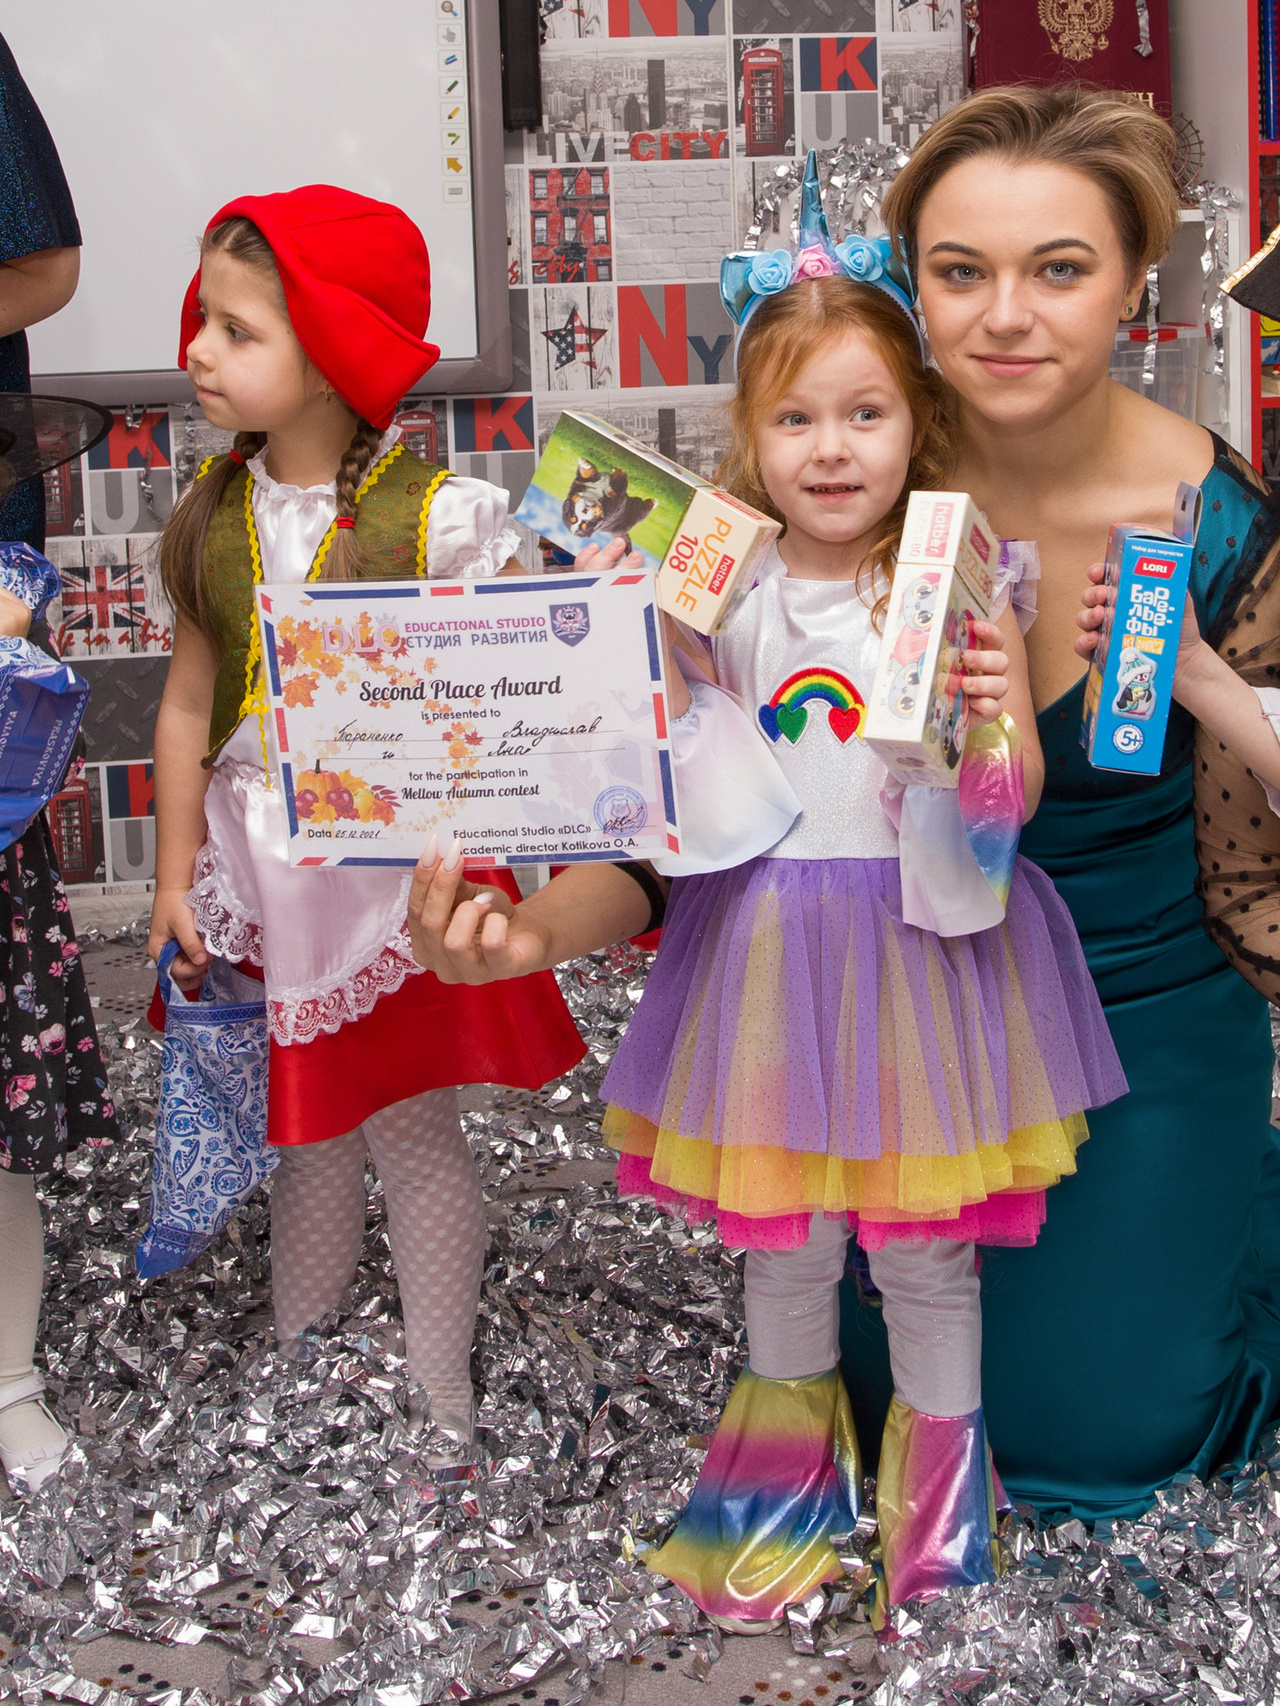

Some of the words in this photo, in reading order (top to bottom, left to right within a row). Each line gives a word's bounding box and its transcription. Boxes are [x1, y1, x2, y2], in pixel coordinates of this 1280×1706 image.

[629, 131, 728, 162] CITY
[474, 396, 534, 452] K
[930, 506, 951, 554] hatber
[668, 534, 698, 573] 108
[675, 516, 732, 612] PUZZLE
[711, 558, 732, 591] hatber
[1142, 562, 1168, 574] LORI
[140, 618, 172, 652] big
[404, 620, 493, 633] EDUCATIONAL
[496, 616, 546, 630] STUDIO
[318, 624, 401, 653] DLC
[406, 634, 462, 650] СТУДИЯ
[471, 630, 548, 646] РАЗВИТИЯ
[359, 680, 427, 702] Second
[430, 679, 486, 700] Place
[490, 675, 564, 700] Award
[421, 711, 429, 720] is
[432, 709, 486, 722] presented
[490, 708, 501, 718] to
[1120, 730, 1142, 746] 5+
[31, 719, 64, 786] PRASKOVIYA
[409, 771, 423, 781] for
[426, 771, 443, 781] the
[446, 768, 516, 782] participation
[518, 768, 528, 778] in
[402, 786, 442, 800] Mellow
[446, 788, 496, 800] Autumn
[498, 784, 541, 797] contest
[308, 829, 332, 838] Data
[454, 826, 518, 840] Educational
[520, 826, 555, 837] Studio
[558, 824, 592, 836] «DLC»
[460, 842, 512, 856] cademic
[515, 842, 560, 854] director
[562, 840, 610, 852] Kotikova
[614, 838, 639, 848] O.A.
